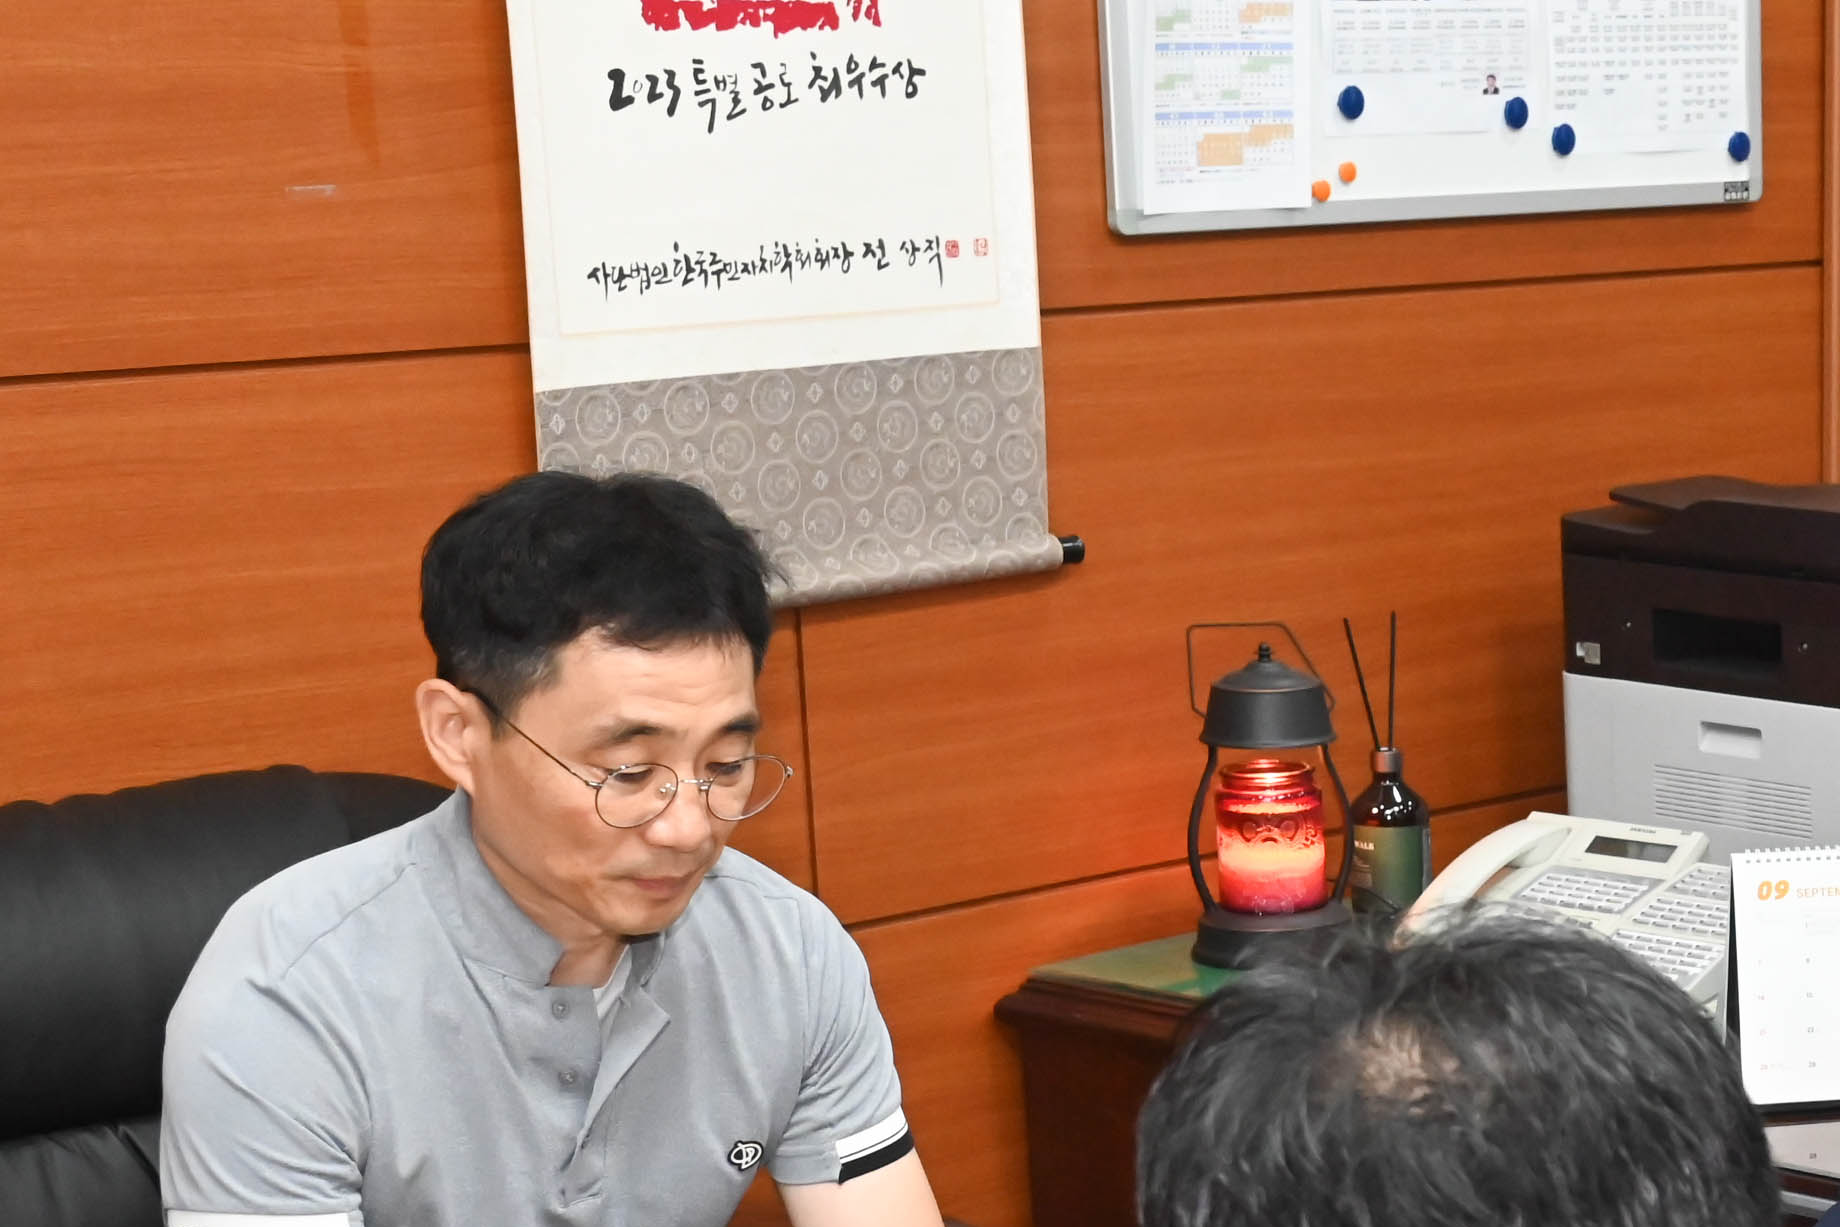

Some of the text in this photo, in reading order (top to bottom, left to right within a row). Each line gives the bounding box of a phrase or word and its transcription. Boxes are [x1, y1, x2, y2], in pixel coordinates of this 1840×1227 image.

[607, 67, 681, 117] 2023
[691, 58, 747, 134] 특별
[808, 51, 927, 103] 최우수상
[1757, 879, 1790, 901] 09
